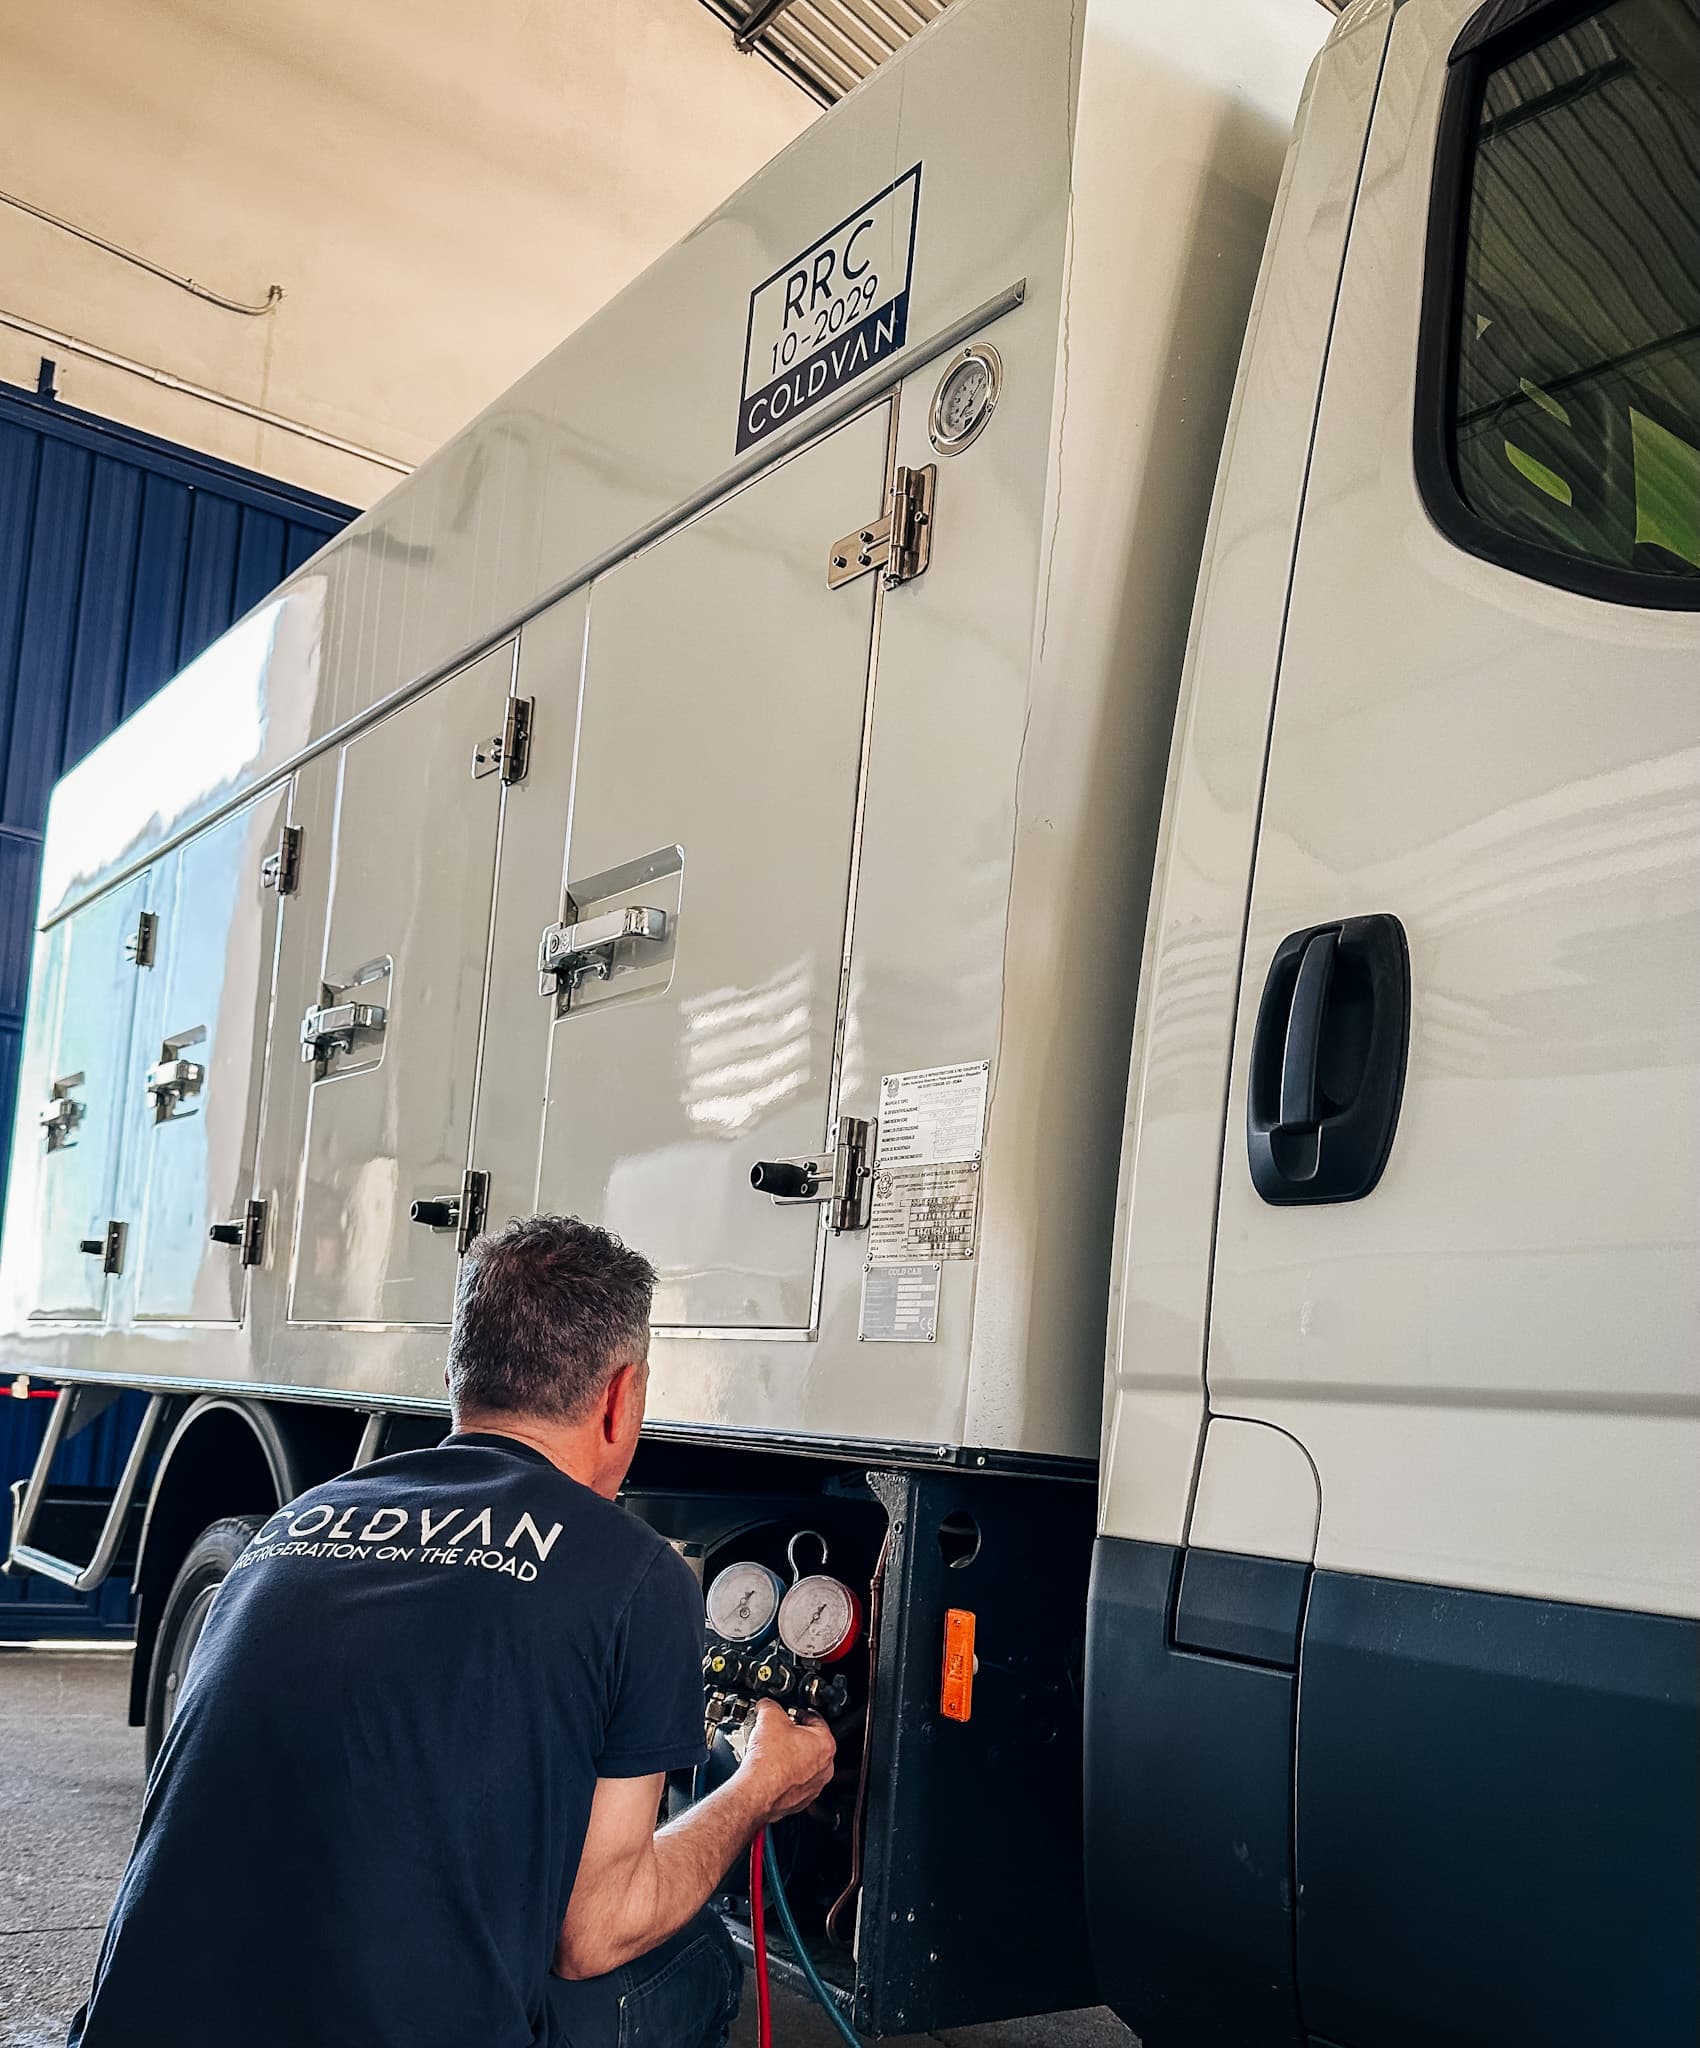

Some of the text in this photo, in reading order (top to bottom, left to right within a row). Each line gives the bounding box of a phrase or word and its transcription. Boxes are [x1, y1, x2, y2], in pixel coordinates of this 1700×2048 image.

[771, 274, 879, 375] 10-2029
[783, 218, 874, 330] RRC
[747, 299, 896, 434] COLDVAN
[235, 1541, 538, 1582] REFRIGERATION ON THE ROAD
[254, 1504, 563, 1562] COLDVAN
